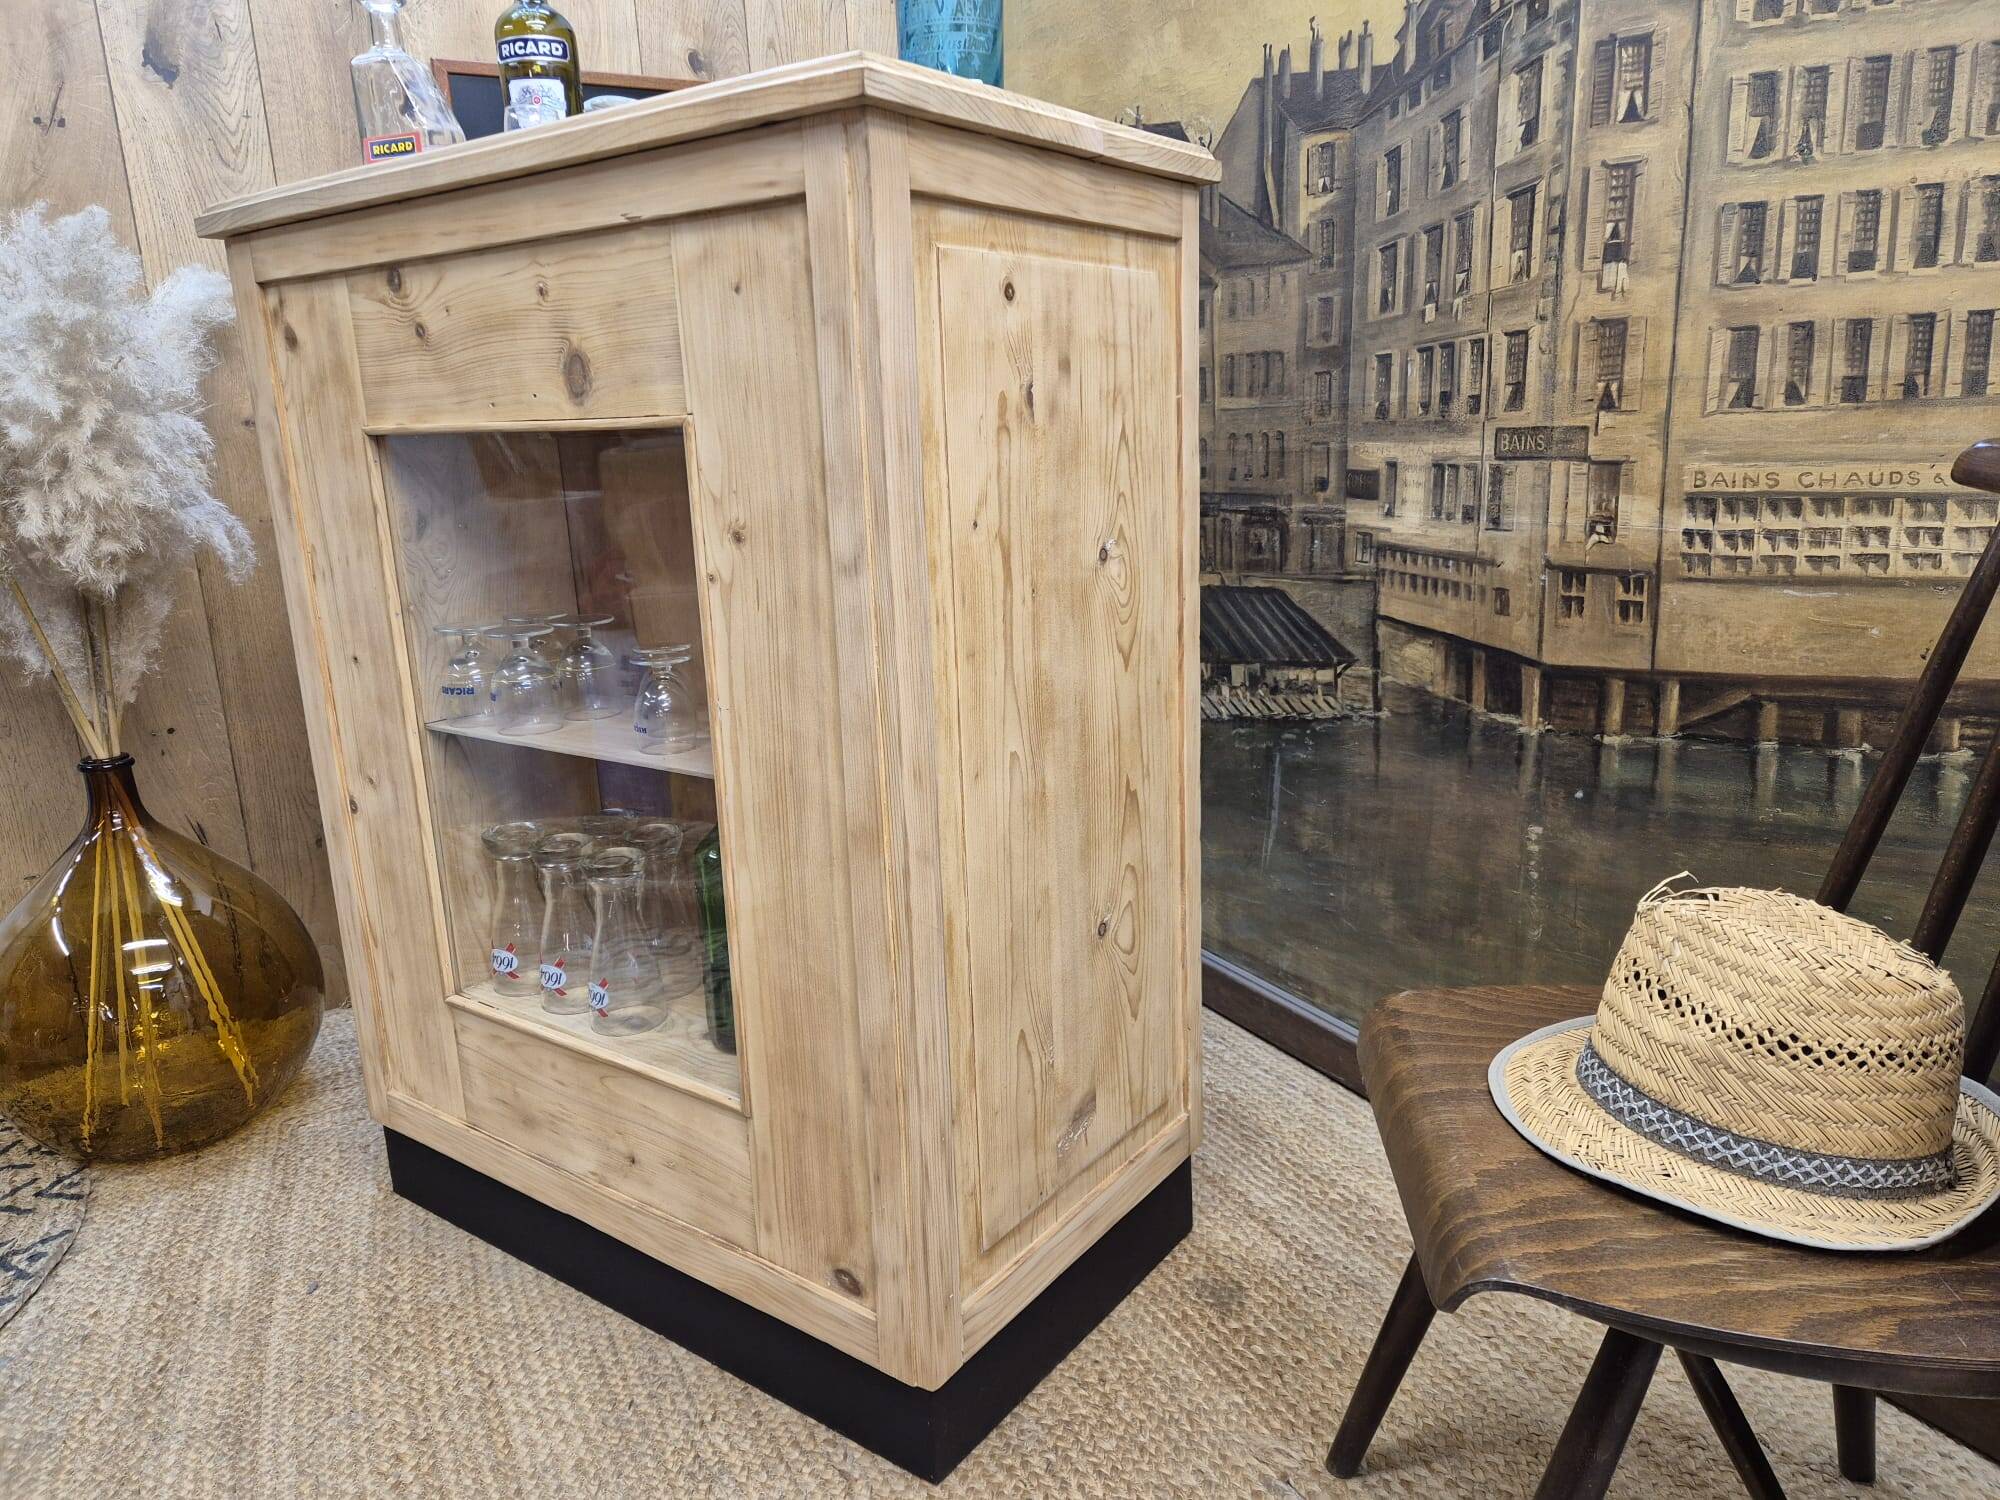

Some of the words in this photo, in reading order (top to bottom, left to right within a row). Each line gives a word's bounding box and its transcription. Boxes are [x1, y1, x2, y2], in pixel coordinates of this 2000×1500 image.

[501, 40, 563, 57] RICARD
[372, 141, 413, 155] RICARD
[1693, 470, 1780, 489] BAINS
[1798, 470, 1921, 489] CHAUDS
